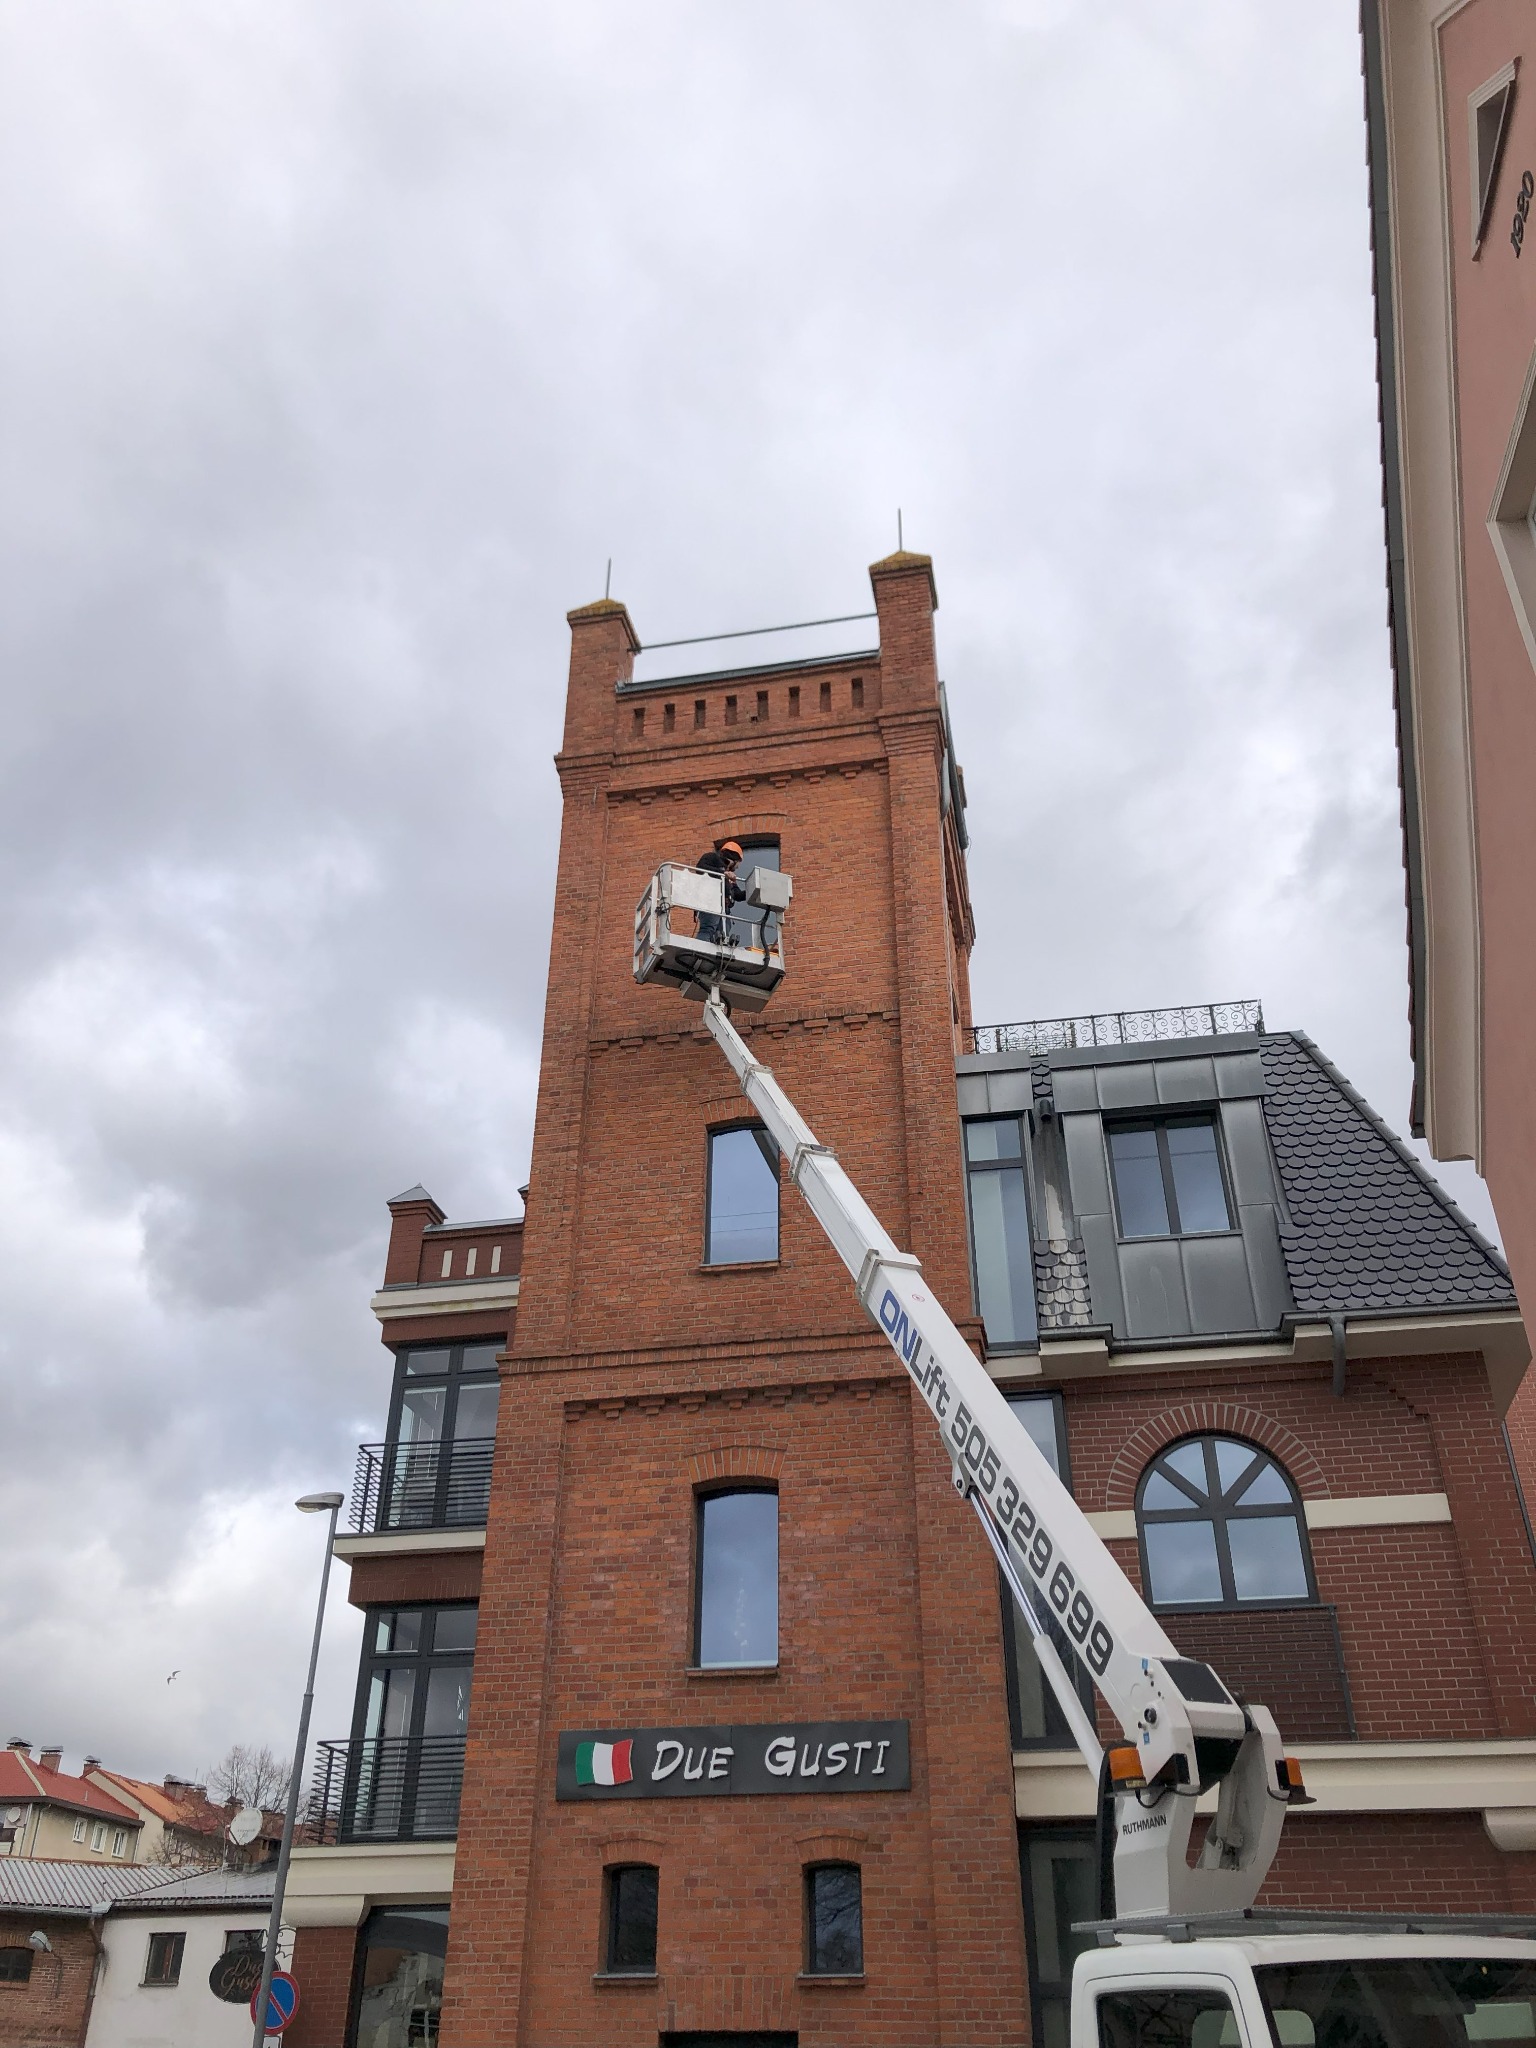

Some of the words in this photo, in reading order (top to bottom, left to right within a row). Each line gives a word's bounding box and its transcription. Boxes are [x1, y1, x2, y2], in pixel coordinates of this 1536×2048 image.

[880, 1289, 951, 1418] ONLift
[951, 1401, 1001, 1494] 505
[996, 1476, 1053, 1579] 329
[1049, 1561, 1114, 1677] 699
[1122, 1814, 1167, 1835] RUTHMANN
[220, 1967, 261, 1998] Gust
